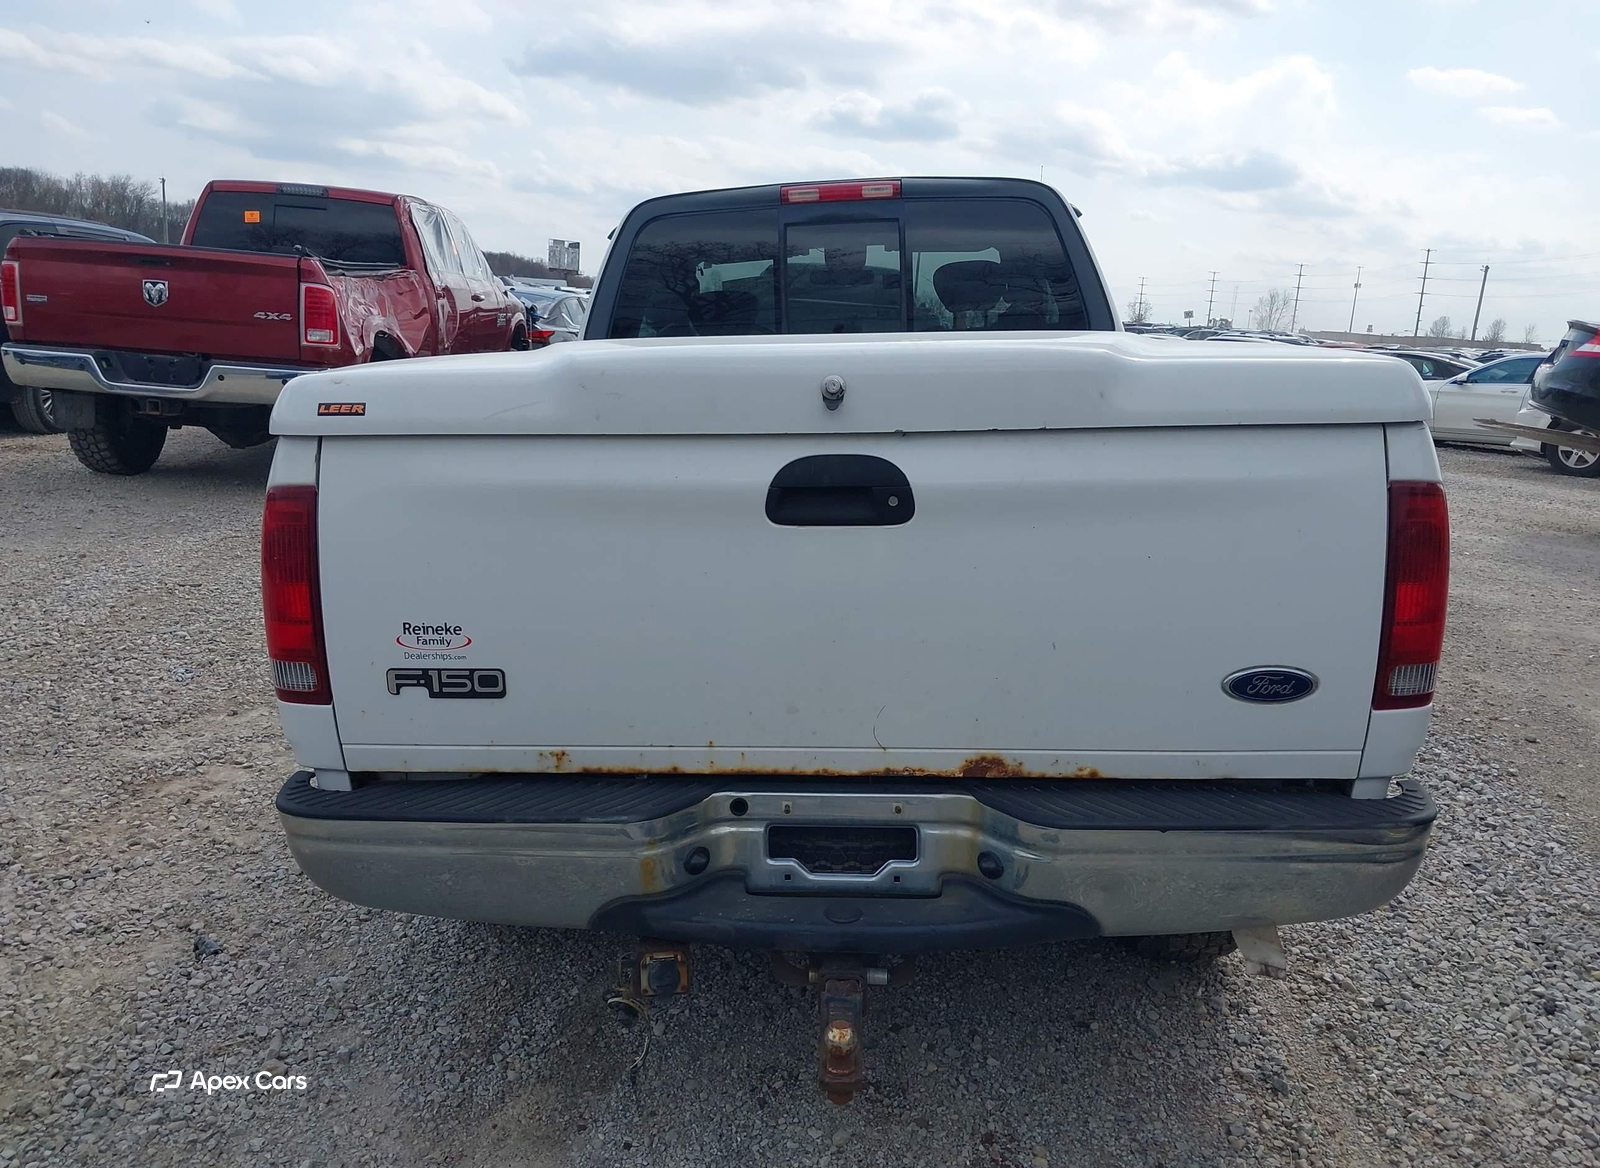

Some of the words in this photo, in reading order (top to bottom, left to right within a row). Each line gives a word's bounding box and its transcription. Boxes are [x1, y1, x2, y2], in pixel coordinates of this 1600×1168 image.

[318, 404, 365, 414] LEER
[402, 622, 463, 636] Reineke
[416, 636, 452, 648] Family
[403, 651, 468, 661] Dealerships.com
[1246, 675, 1296, 695] Ford
